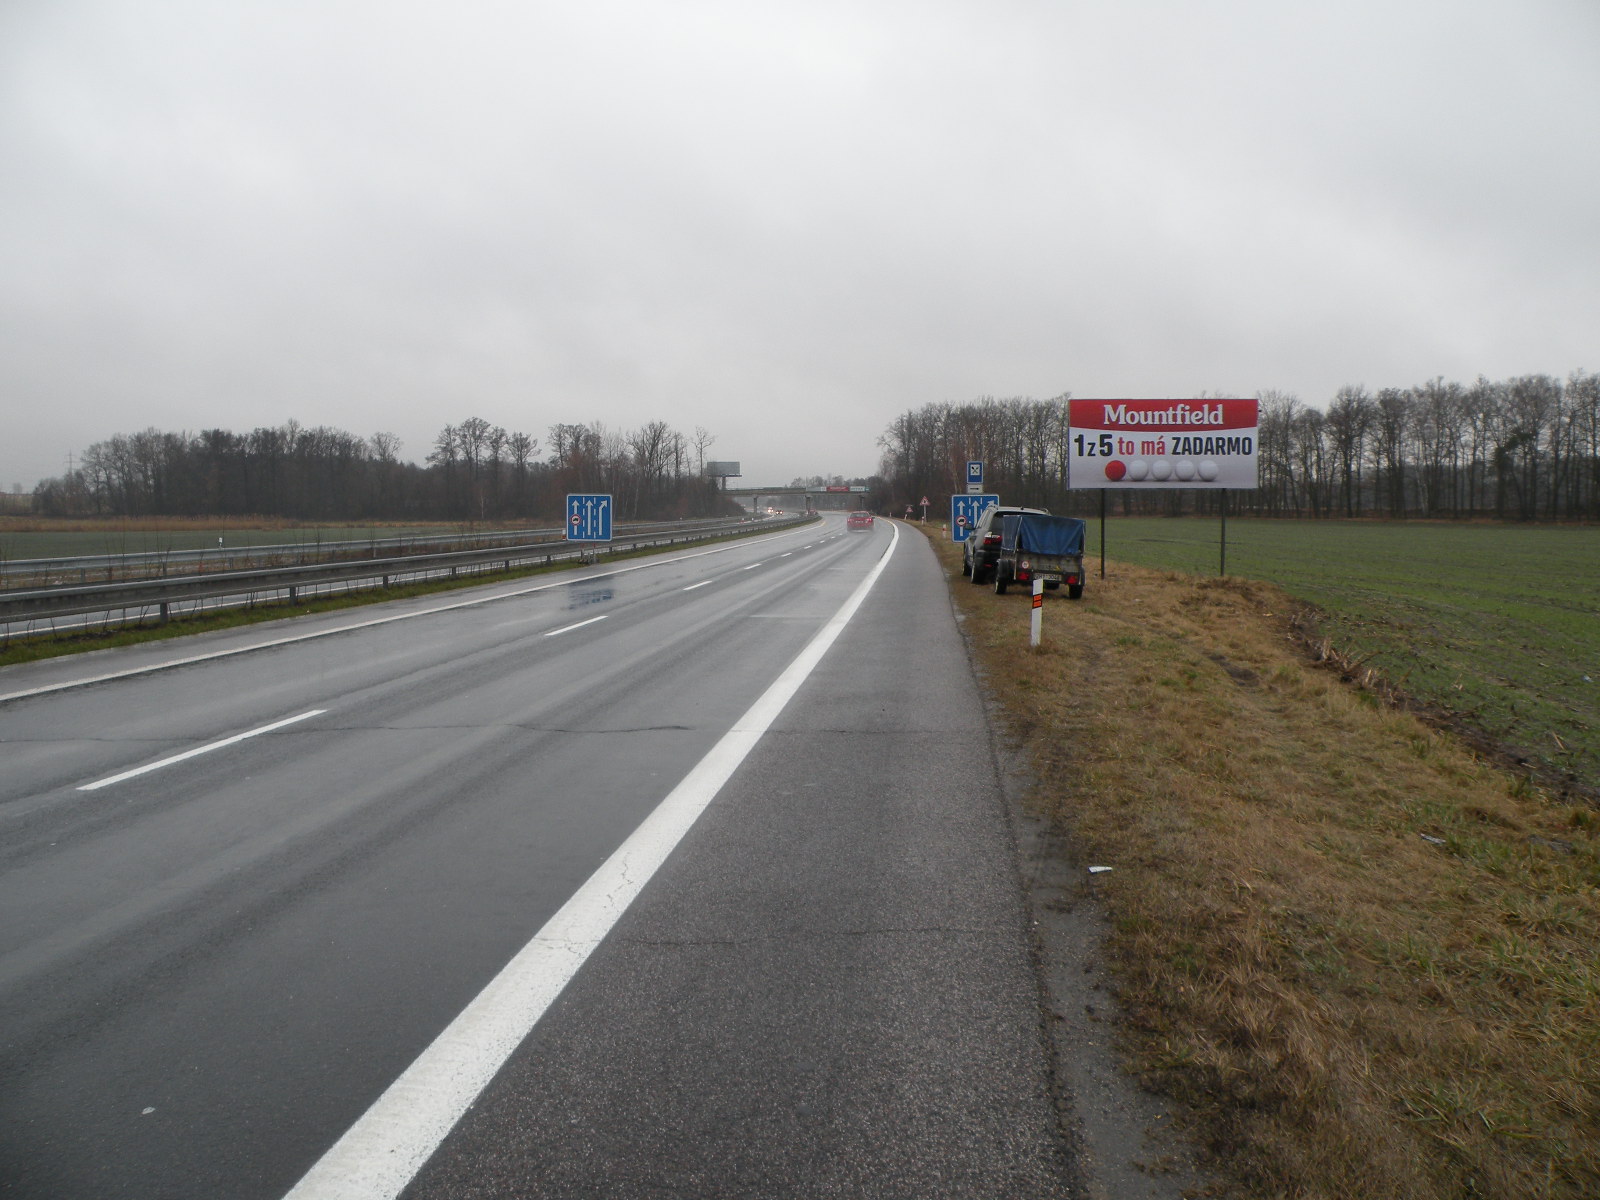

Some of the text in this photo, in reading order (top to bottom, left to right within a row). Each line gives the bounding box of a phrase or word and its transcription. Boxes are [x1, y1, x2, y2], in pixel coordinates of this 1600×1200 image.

[1103, 403, 1224, 425] Mountfield
[1118, 437, 1135, 455] to
[1141, 435, 1166, 455] má
[1171, 436, 1253, 455] ZADARMO
